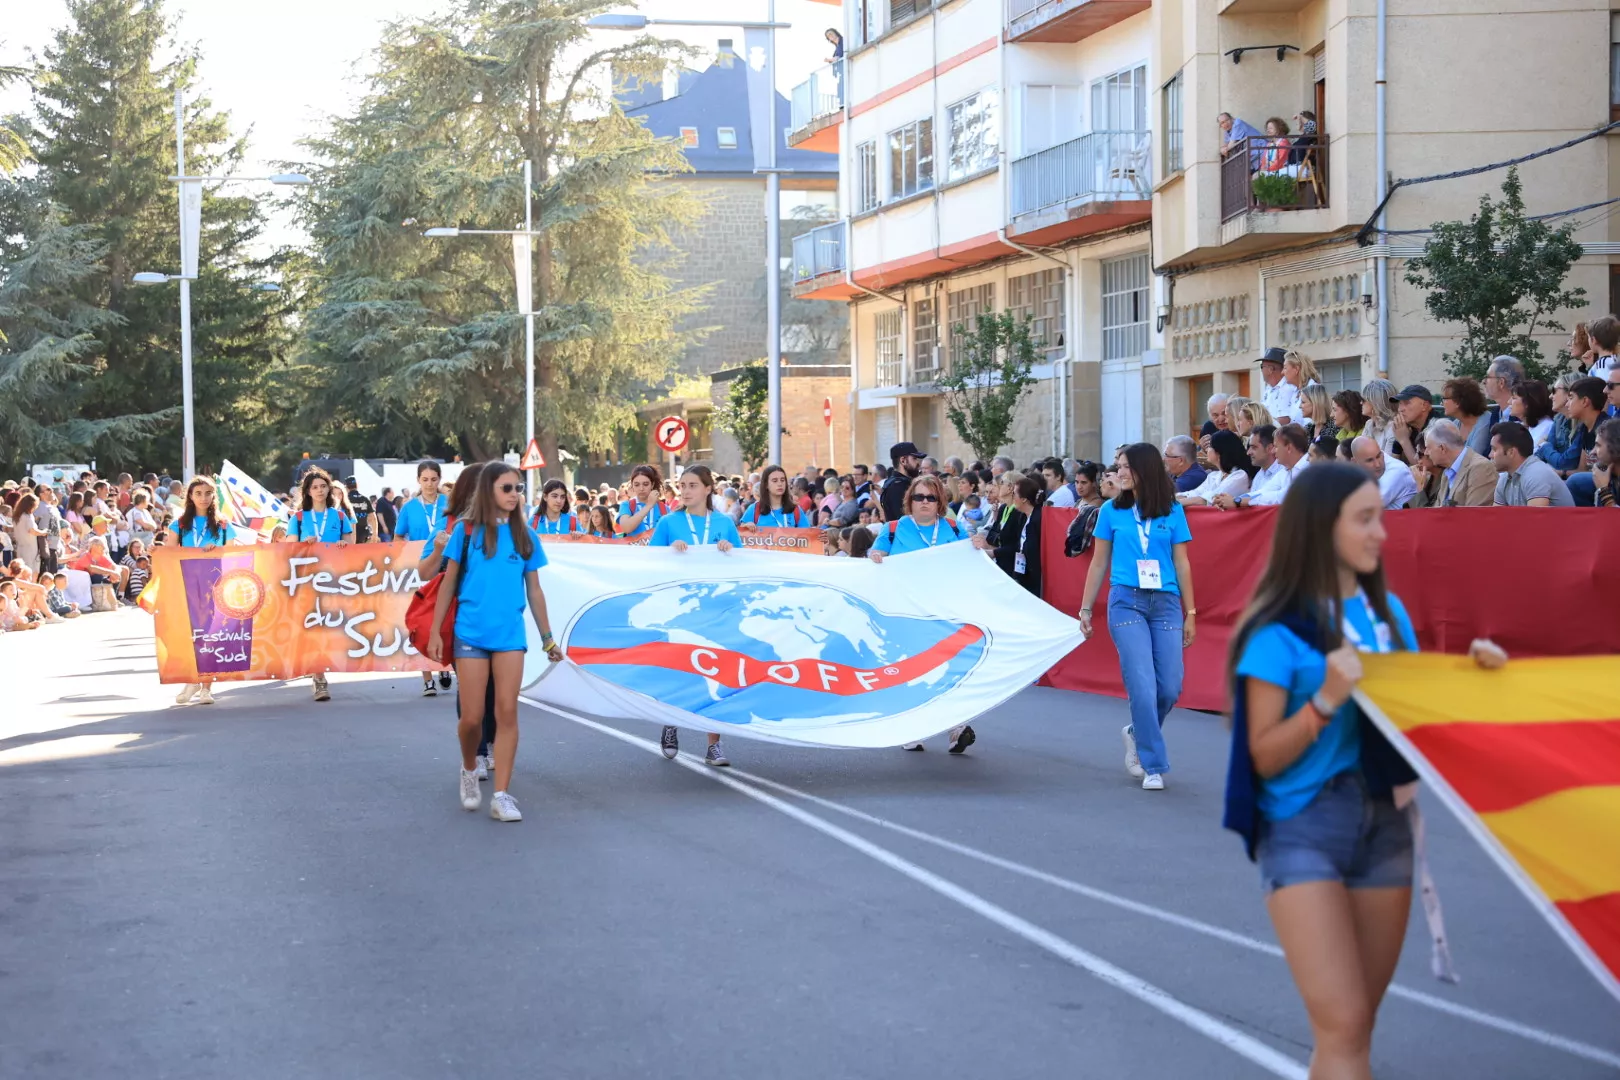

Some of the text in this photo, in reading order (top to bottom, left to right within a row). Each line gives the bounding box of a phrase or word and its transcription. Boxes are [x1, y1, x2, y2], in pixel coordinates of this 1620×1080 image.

[281, 556, 430, 597] Festiva
[303, 596, 344, 629] du
[191, 627, 252, 642] Festivals
[199, 642, 248, 663] du Sud
